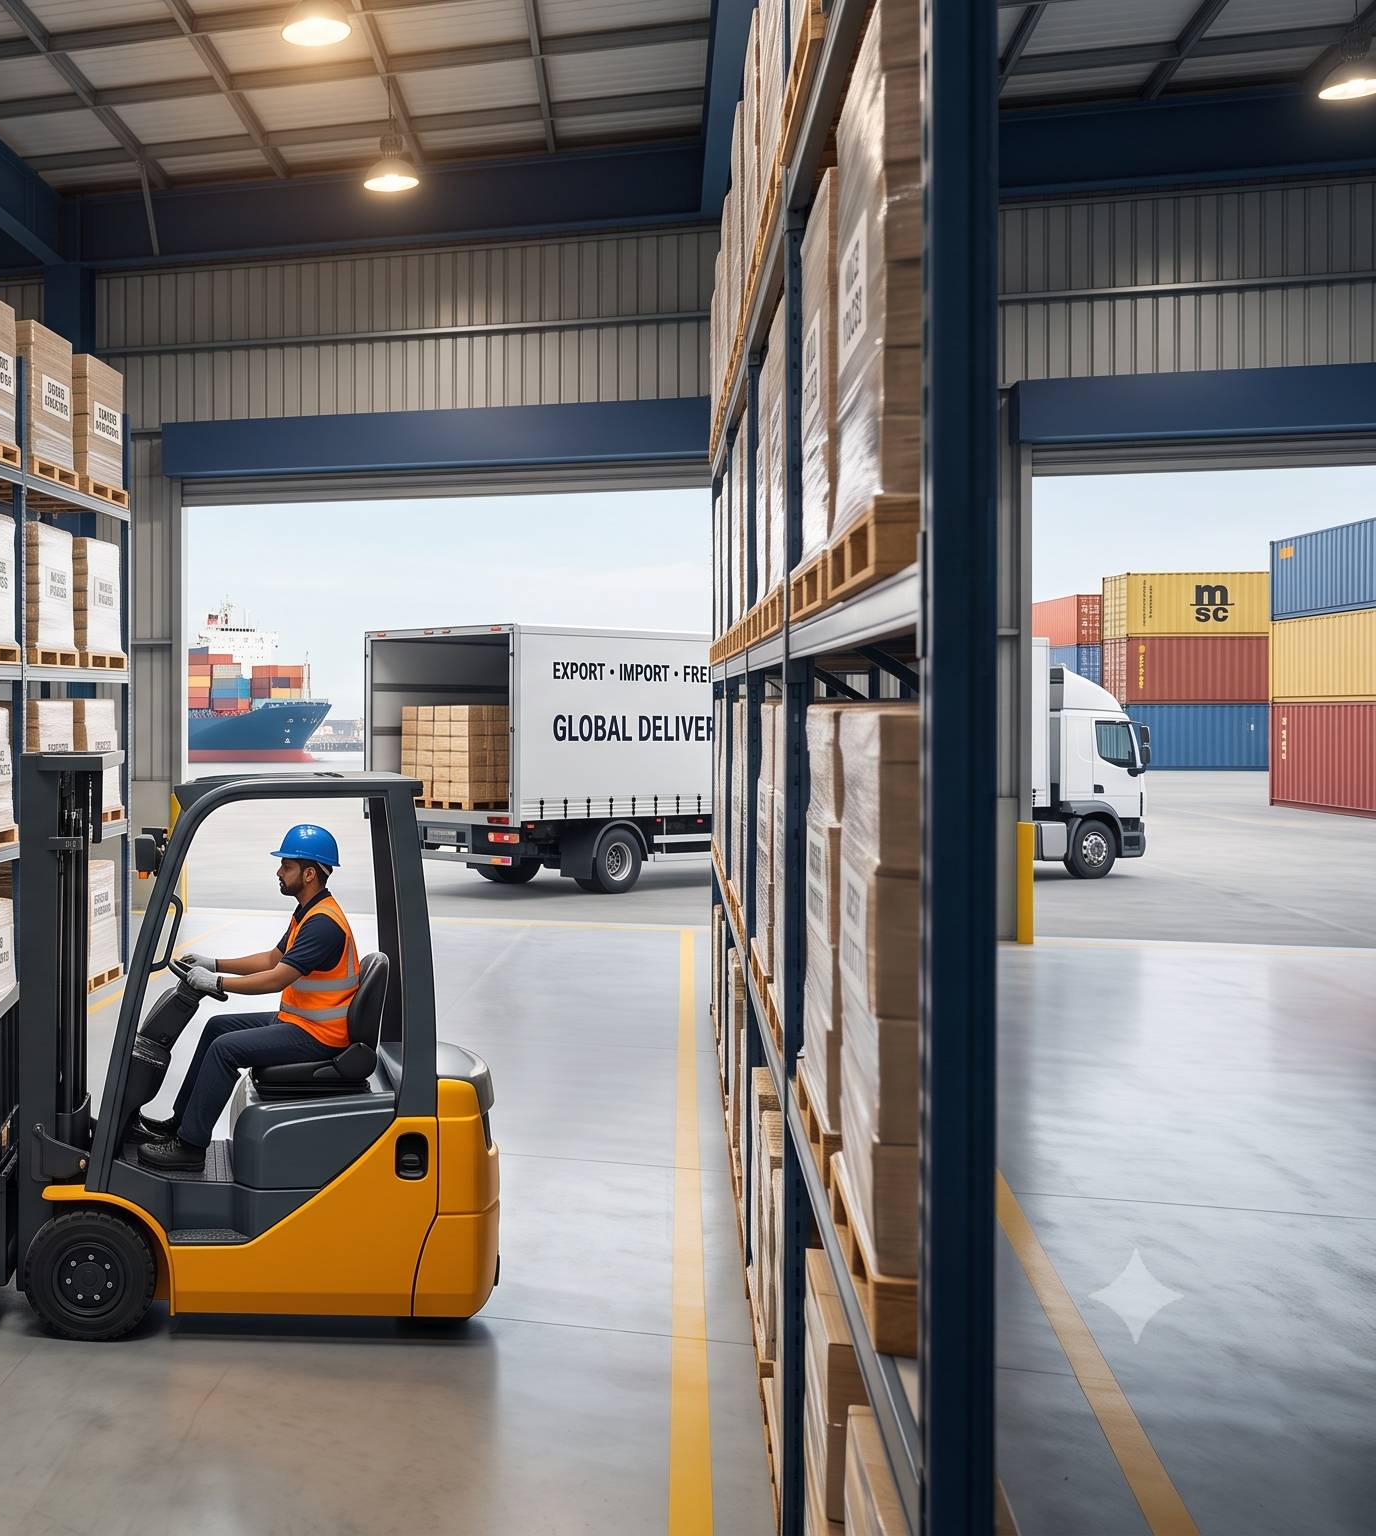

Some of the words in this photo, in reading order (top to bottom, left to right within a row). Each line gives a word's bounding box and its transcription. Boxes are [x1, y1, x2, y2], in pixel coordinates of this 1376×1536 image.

[552, 661, 606, 681] EXPORT
[619, 663, 670, 682] IMPORT
[552, 714, 633, 742] GLOBAL
